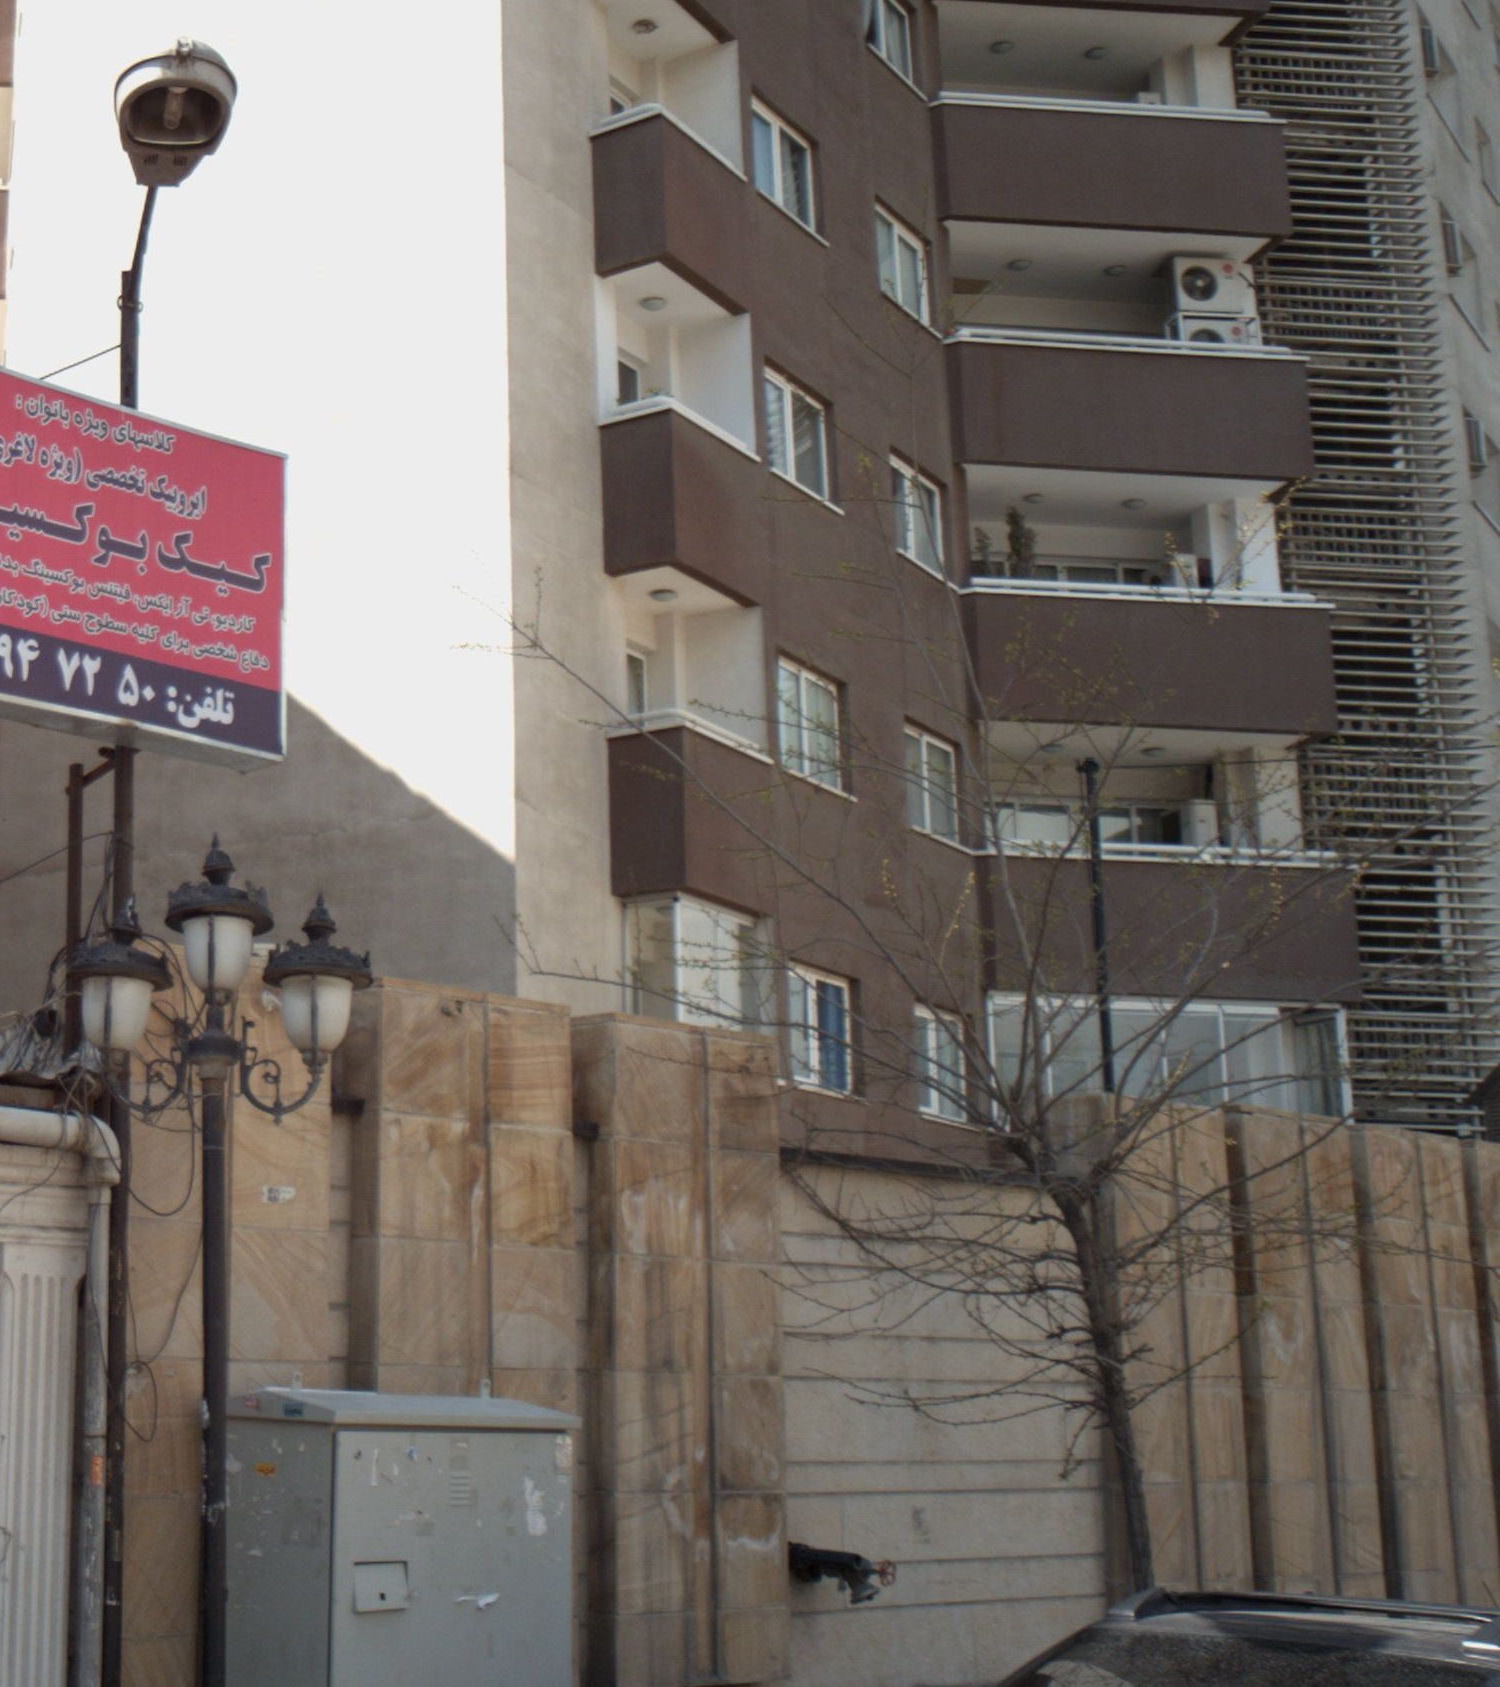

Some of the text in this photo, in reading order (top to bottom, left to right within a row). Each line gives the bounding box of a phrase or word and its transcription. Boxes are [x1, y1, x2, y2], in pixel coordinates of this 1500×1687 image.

[73, 409, 109, 441] ویژه
[112, 420, 175, 453] کلاسهای
[85, 465, 146, 495] تخصصی
[155, 532, 271, 598] کیک
[88, 582, 131, 603] فیتنس
[51, 606, 82, 625] سنی
[83, 611, 127, 633] سطوح
[131, 623, 159, 645] کلیه
[161, 631, 189, 654] برای
[192, 643, 237, 661] شخصی
[239, 650, 269, 672] دفاع
[57, 647, 102, 697] ۷۲
[117, 663, 156, 707] ۵۰
